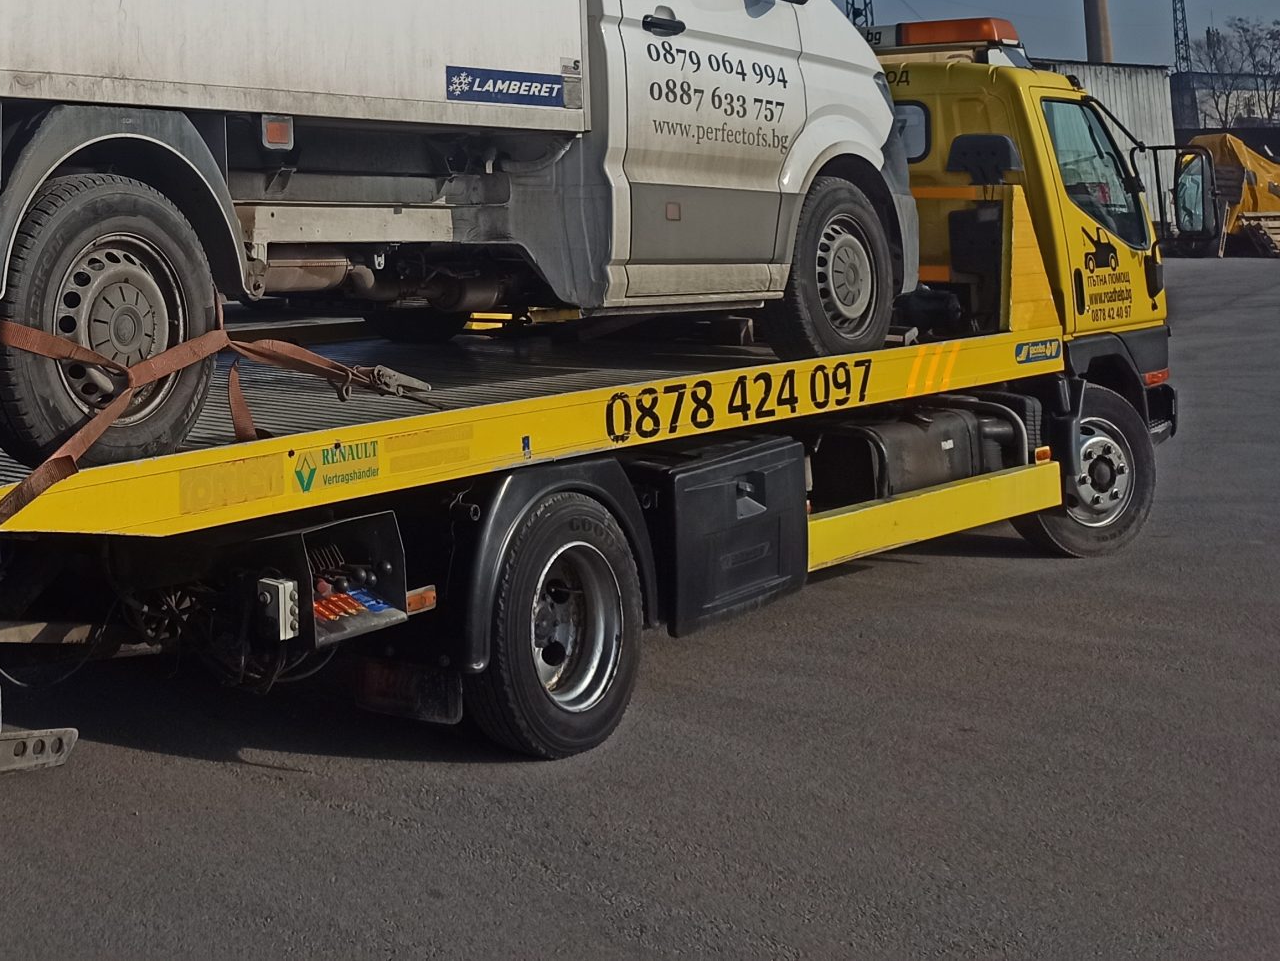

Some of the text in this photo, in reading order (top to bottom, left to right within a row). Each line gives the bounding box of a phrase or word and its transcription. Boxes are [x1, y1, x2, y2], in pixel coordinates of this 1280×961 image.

[646, 41, 788, 89] 0879 064 994
[472, 78, 562, 98] LAMBERET
[649, 79, 785, 124] 0887 633 757
[652, 117, 789, 155] www.perfectofs.bg
[605, 358, 872, 444] 0878 424 097
[321, 440, 378, 466] RENAULT
